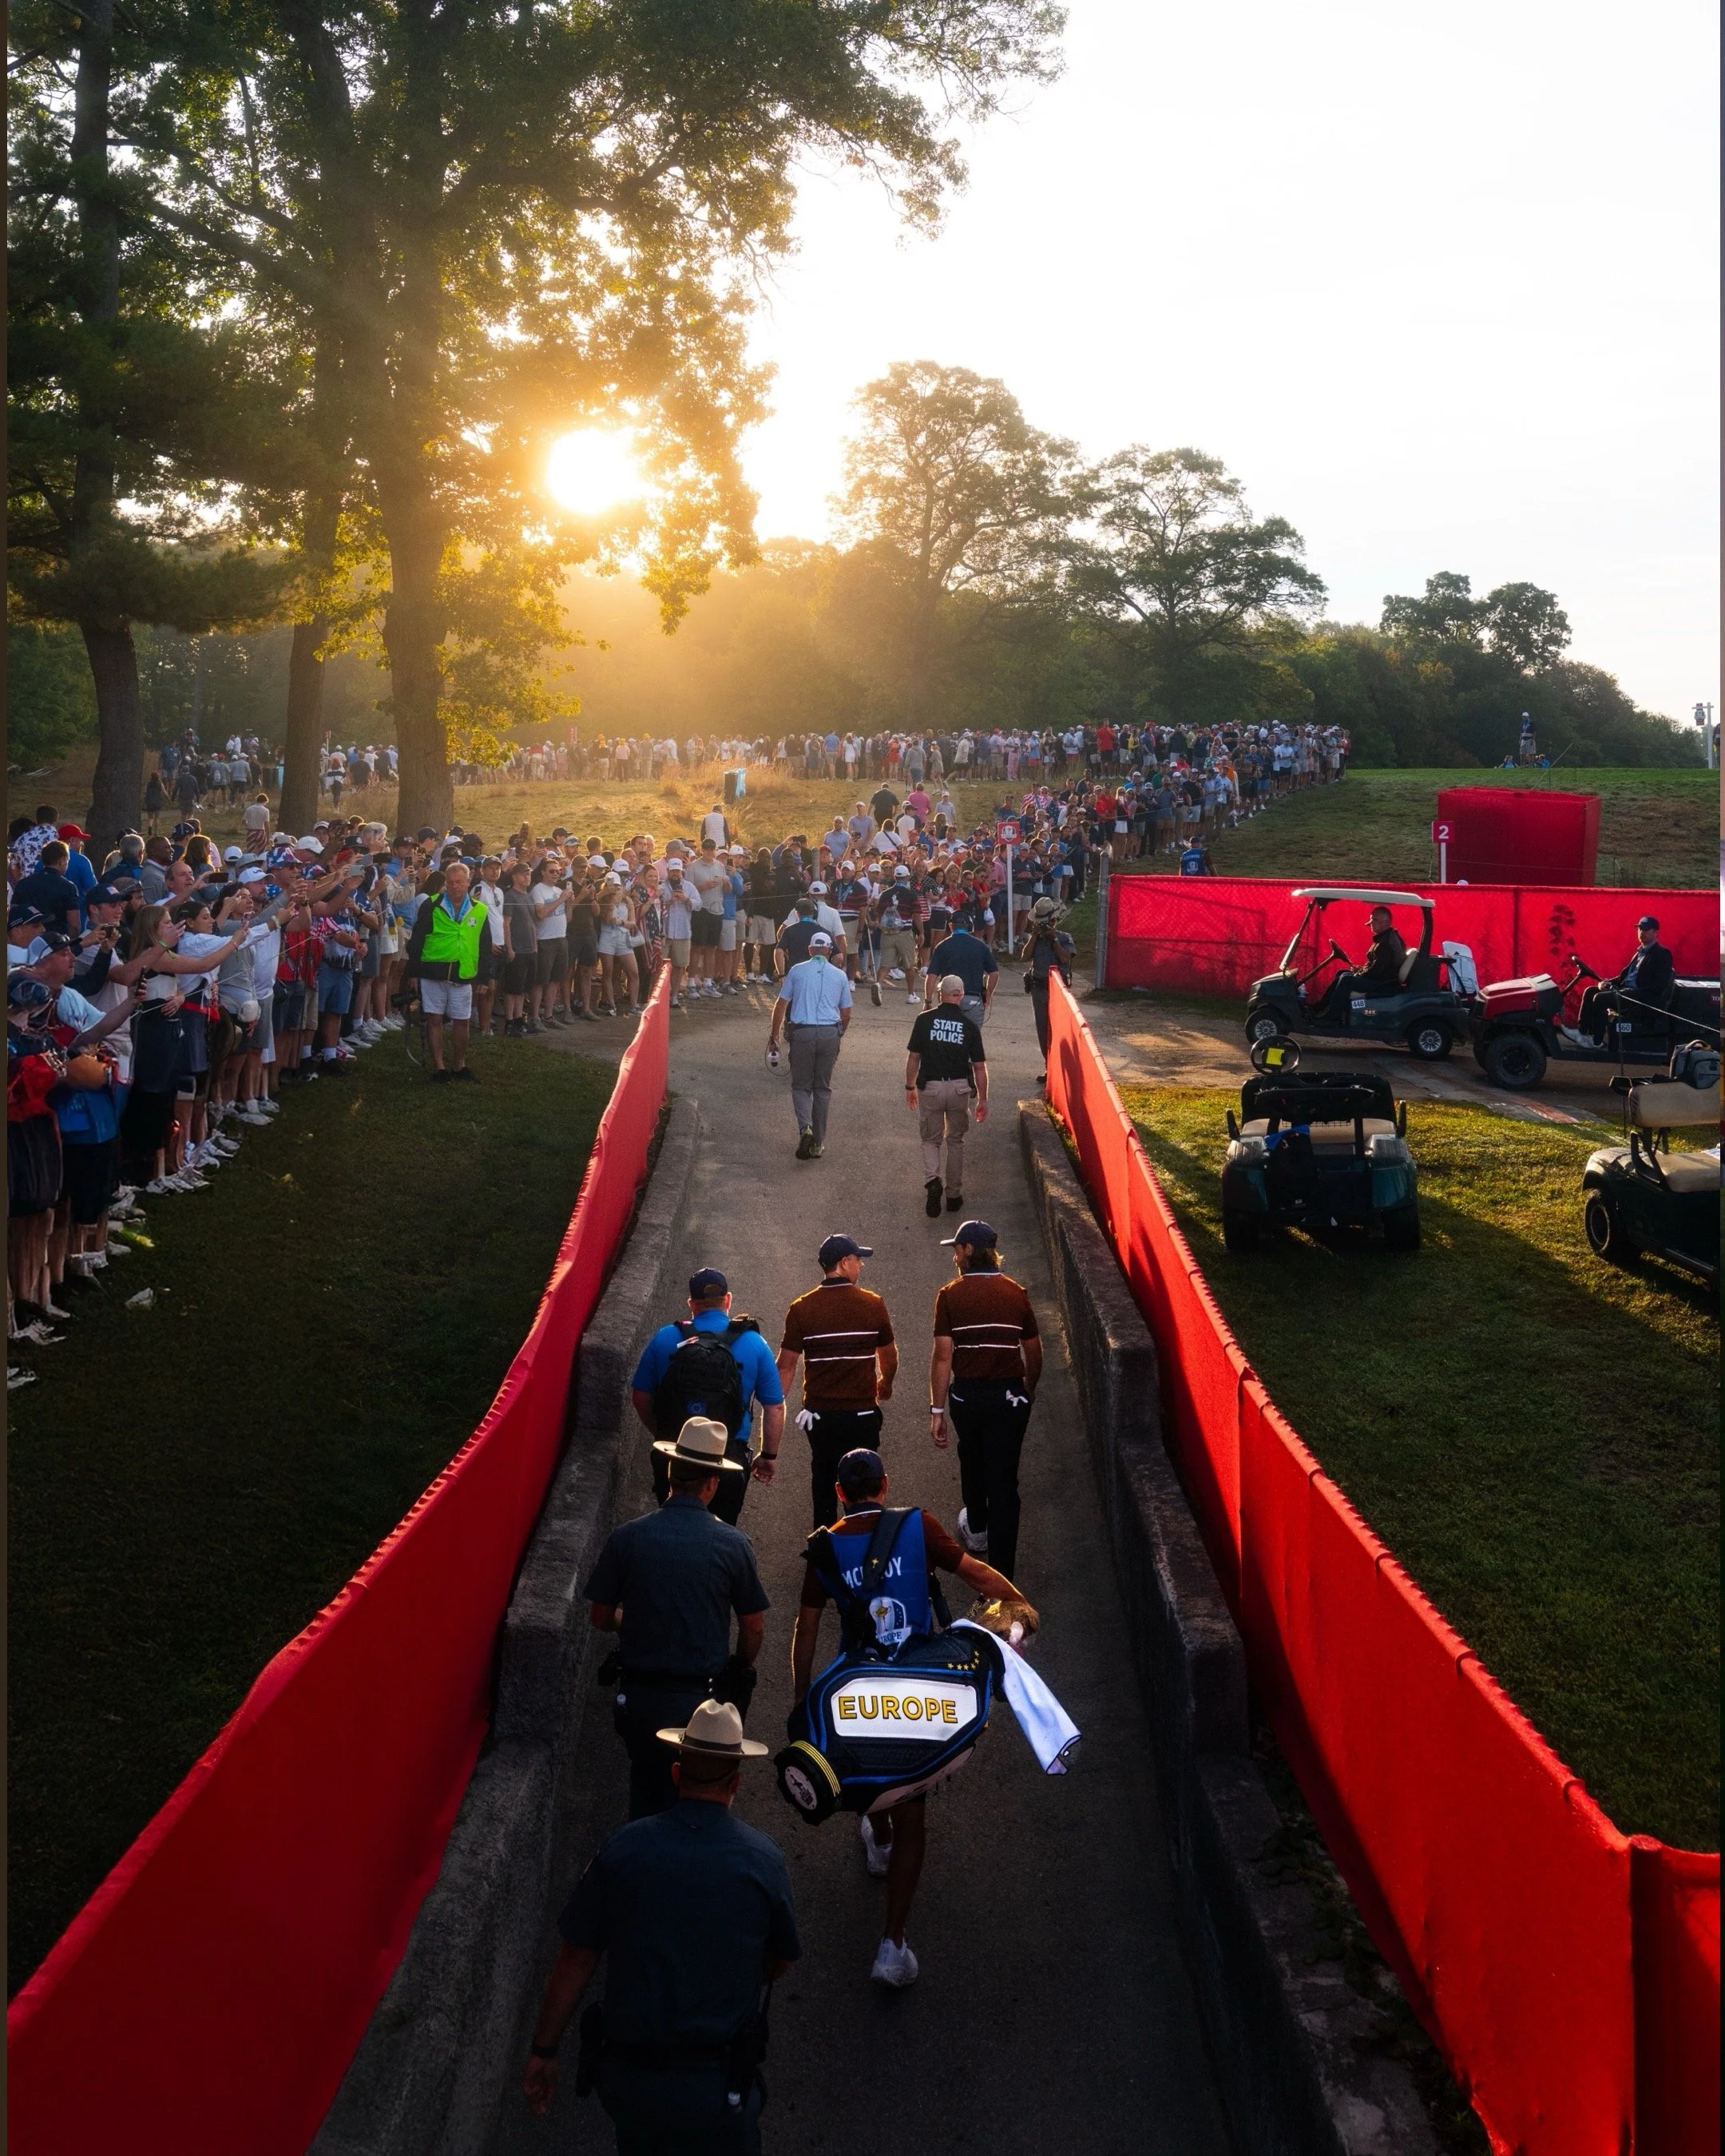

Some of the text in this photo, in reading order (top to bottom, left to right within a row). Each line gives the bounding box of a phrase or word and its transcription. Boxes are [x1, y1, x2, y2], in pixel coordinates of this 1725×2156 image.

[1438, 825, 1449, 838] 2
[933, 1018, 964, 1032] STATE
[930, 1029, 965, 1044] POLICE
[880, 1631, 902, 1643] ROPE
[839, 1695, 958, 1723] EUROPE
